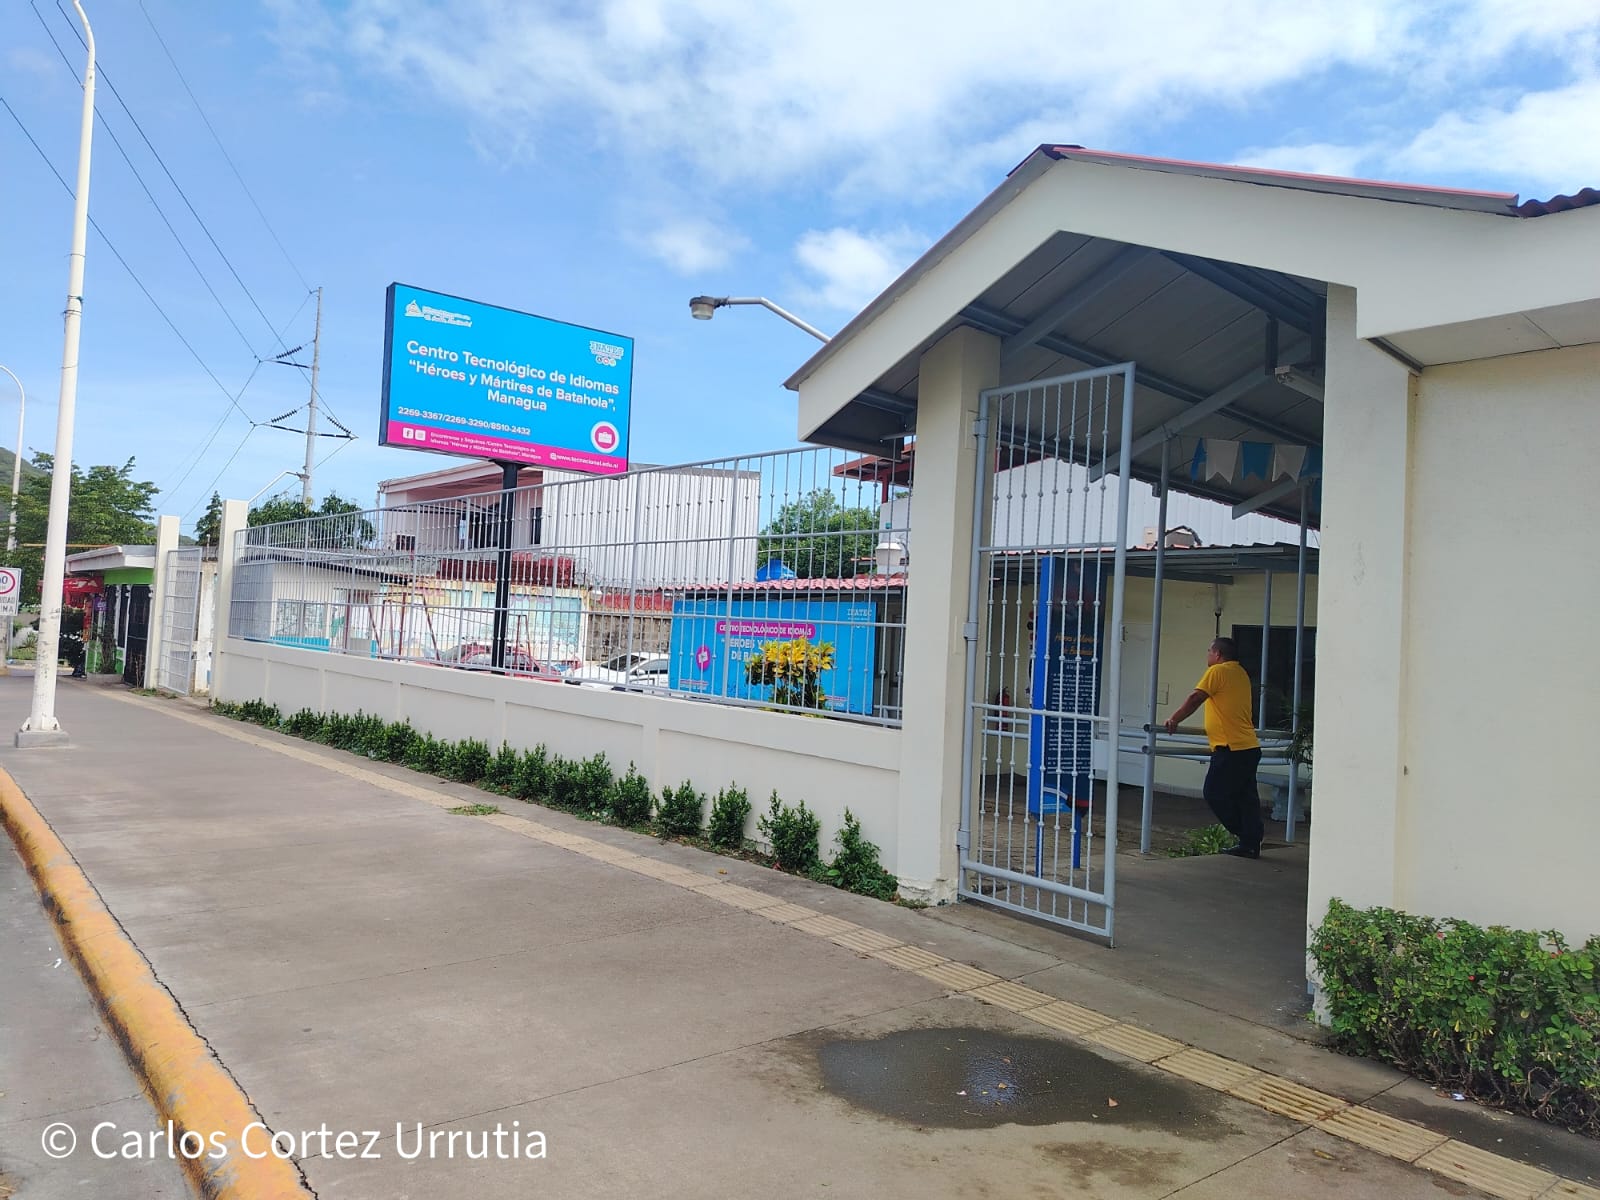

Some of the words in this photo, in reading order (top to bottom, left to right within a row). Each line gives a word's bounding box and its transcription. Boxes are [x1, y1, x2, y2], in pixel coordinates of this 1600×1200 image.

[407, 340, 459, 362] Centro
[462, 351, 546, 378] Tecnológico
[549, 370, 567, 384] de
[570, 373, 620, 394] Idiomas
[408, 359, 466, 381] “Héroes
[469, 373, 478, 386] y
[481, 373, 534, 394] Mártires
[536, 385, 553, 398] de
[487, 389, 547, 411] Managua
[787, 627, 812, 636] IDOMAS
